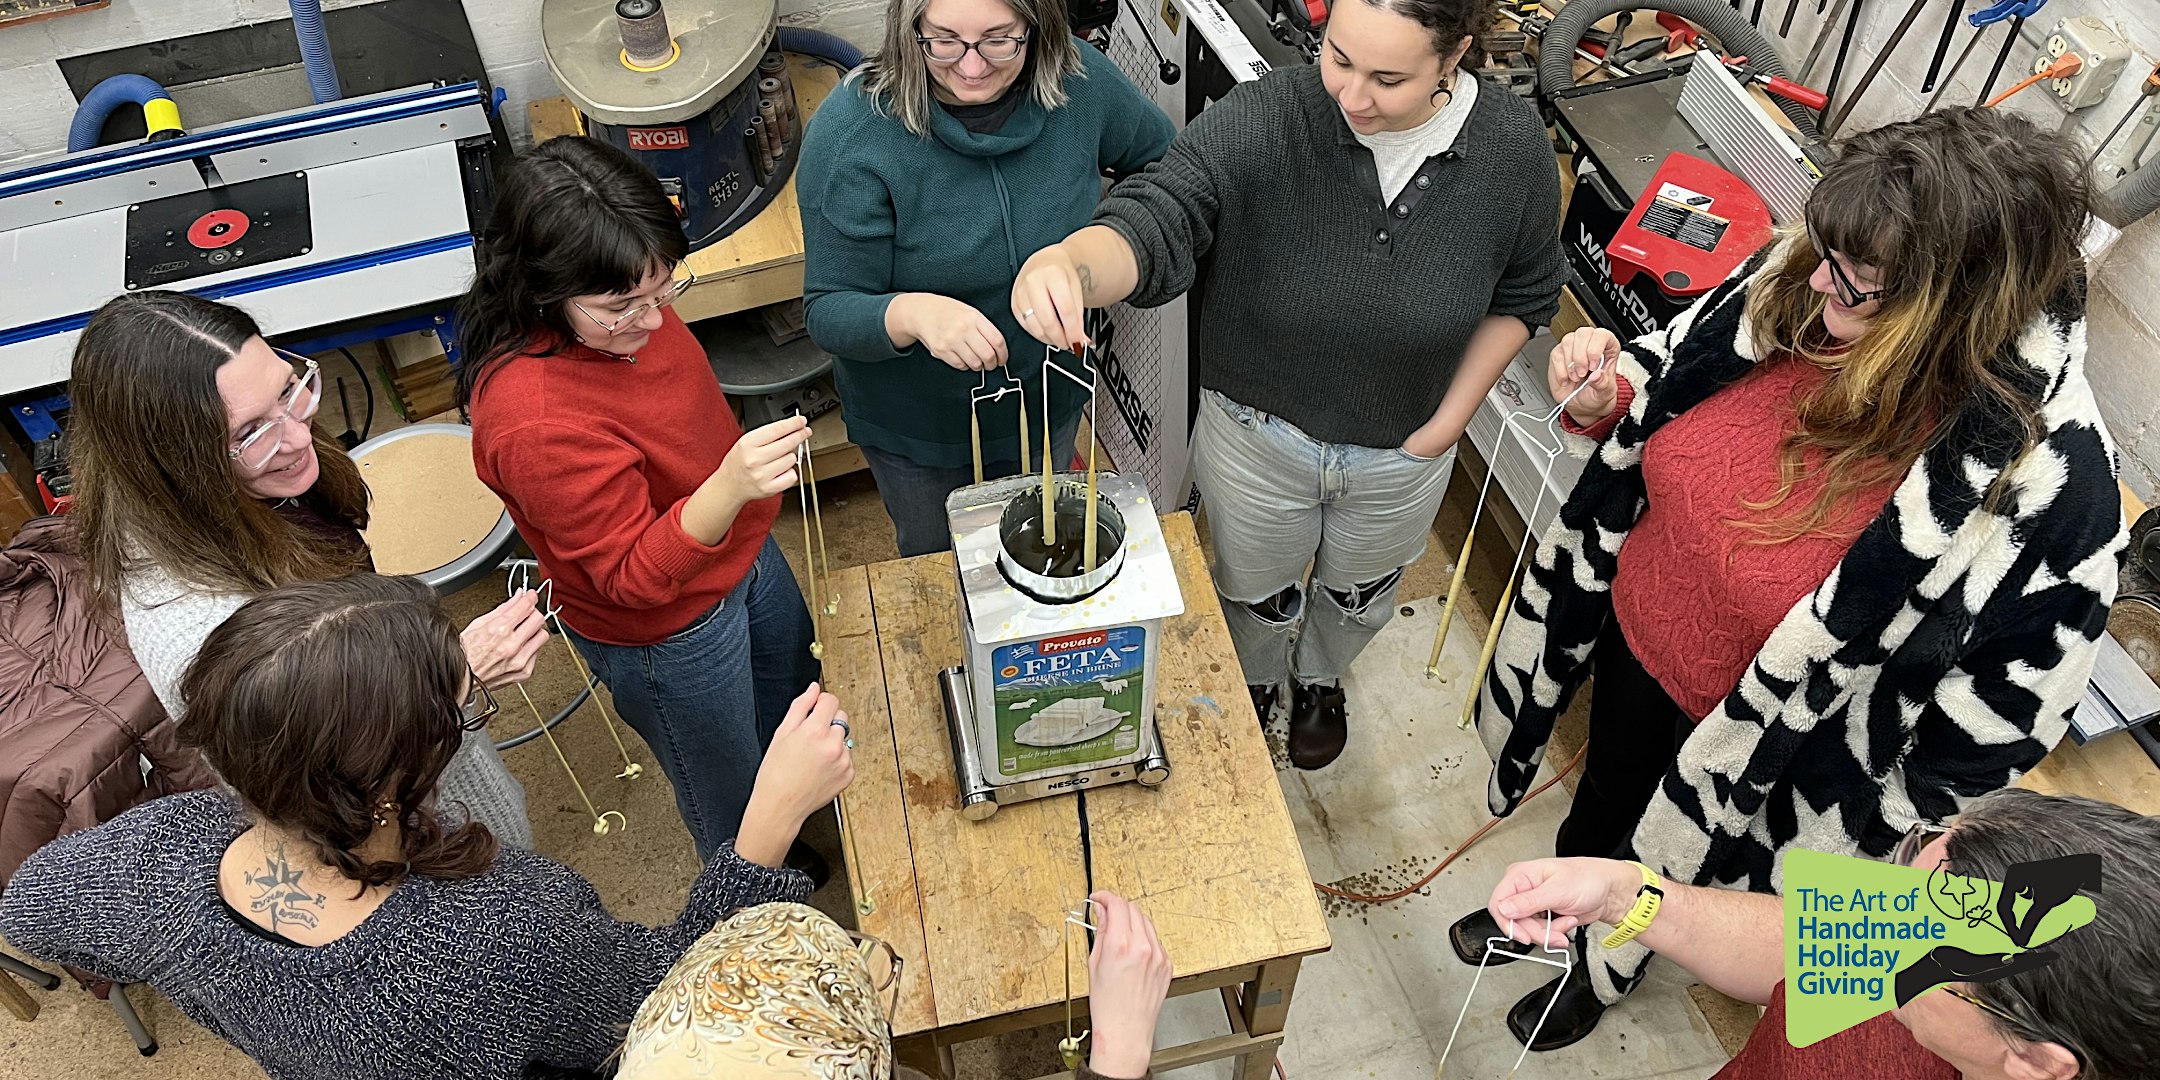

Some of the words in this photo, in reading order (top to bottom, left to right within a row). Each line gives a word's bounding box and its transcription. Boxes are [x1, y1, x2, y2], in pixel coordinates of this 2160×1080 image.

[629, 130, 685, 146] RYOBI
[711, 181, 739, 208] 3430
[1580, 222, 1657, 334] WAUDA
[1598, 273, 1628, 317] TOOLS
[805, 399, 838, 419] ELTA
[1043, 636, 1102, 652] Provato
[1023, 647, 1121, 676] FETA
[1087, 662, 1121, 672] BRINE
[1047, 778, 1090, 790] NESCO
